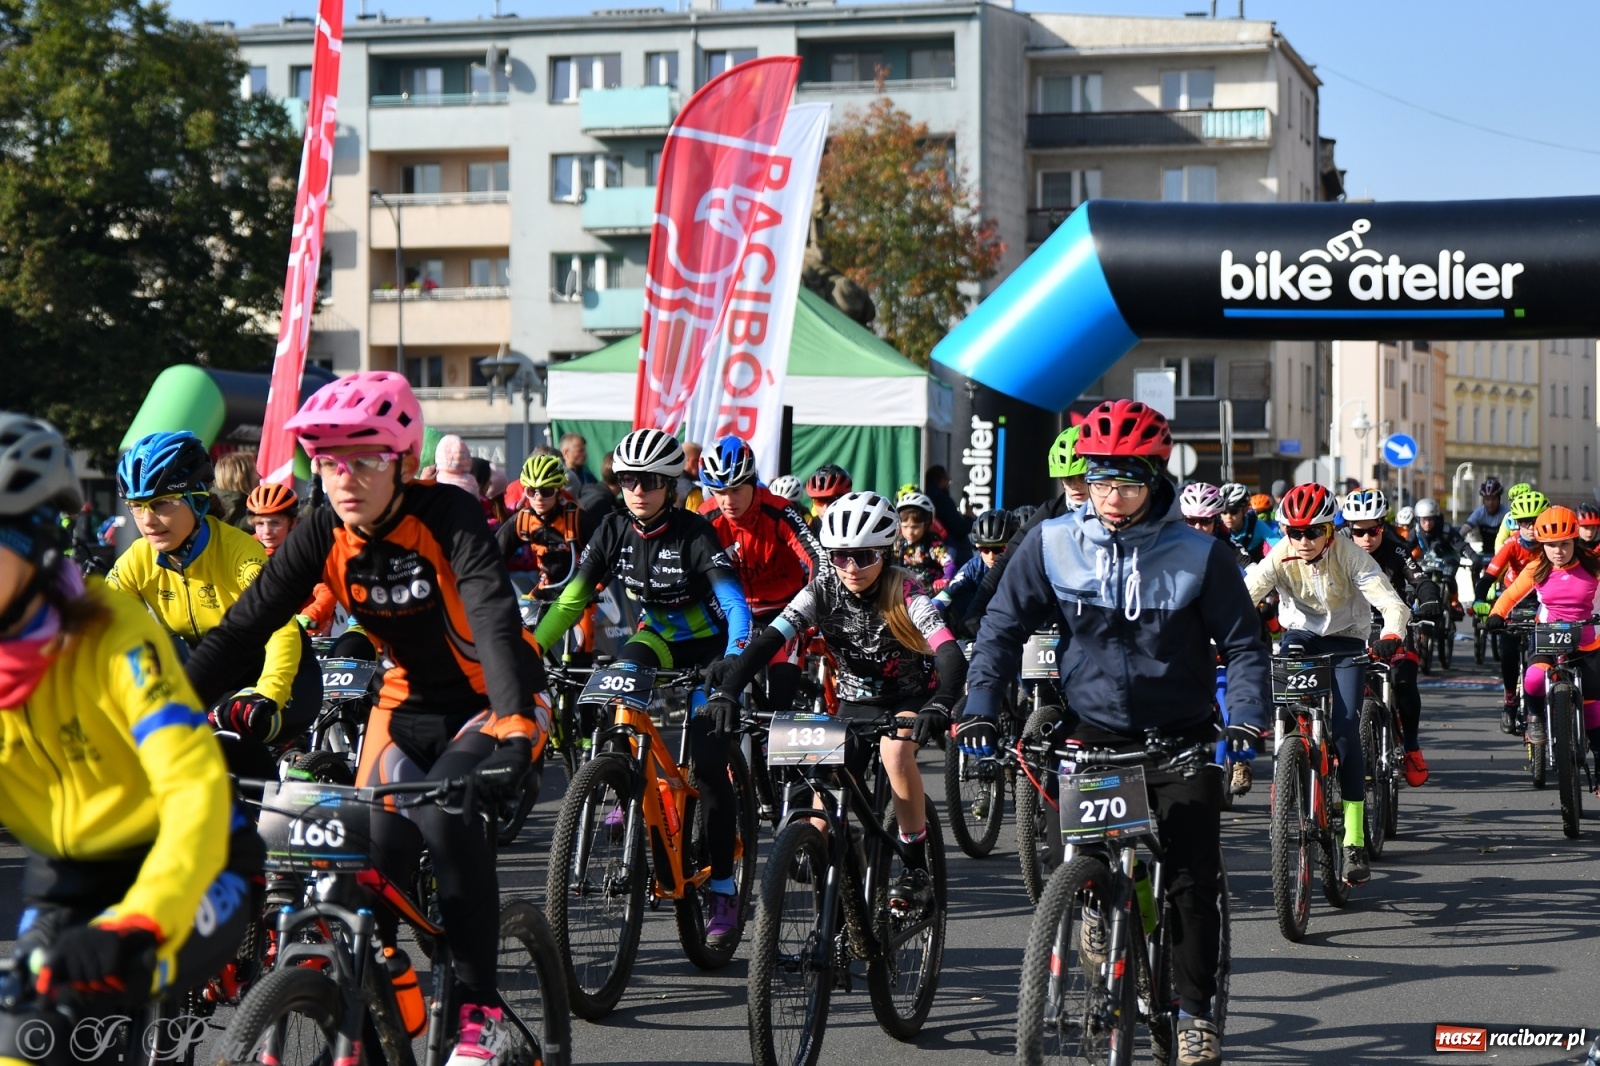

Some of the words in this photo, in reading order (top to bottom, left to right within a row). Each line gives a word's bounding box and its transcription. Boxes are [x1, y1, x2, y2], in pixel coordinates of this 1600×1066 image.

[1220, 249, 1333, 301] bike
[1348, 249, 1525, 301] atelier
[714, 154, 793, 441] RACIBÓR
[961, 414, 994, 517] atelier
[1549, 632, 1572, 644] 178
[1037, 650, 1056, 664] 10
[598, 675, 636, 693] 305
[1287, 674, 1318, 690] 226
[787, 727, 826, 747] 133
[1079, 796, 1127, 823] 270
[288, 819, 345, 848] 160
